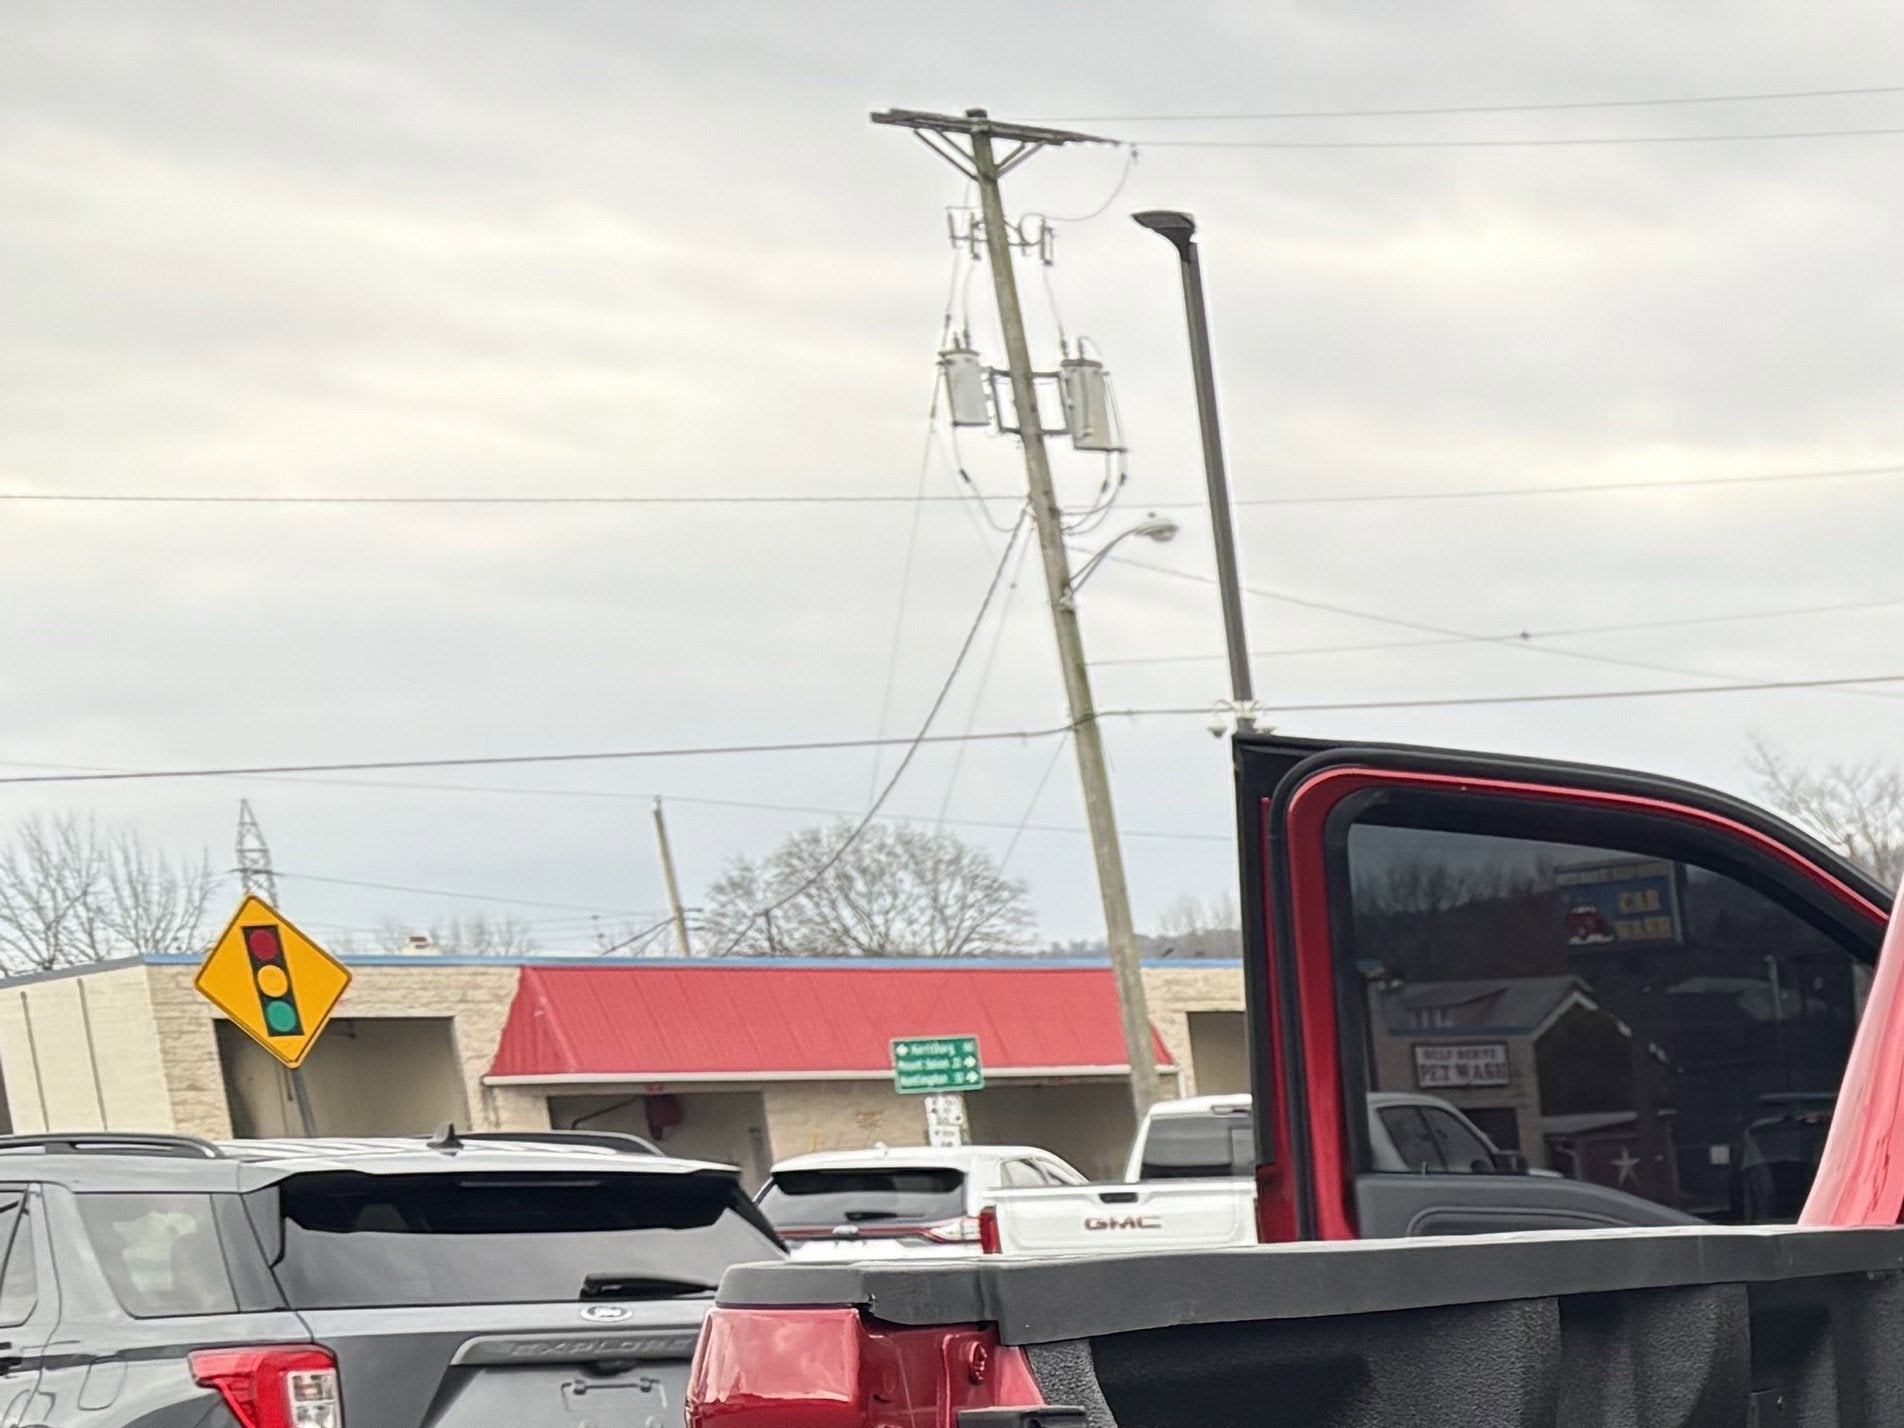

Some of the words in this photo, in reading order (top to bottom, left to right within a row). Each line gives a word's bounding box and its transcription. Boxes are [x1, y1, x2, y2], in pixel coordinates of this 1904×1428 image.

[1617, 889, 1661, 914] CAR
[1615, 916, 1673, 939] WASH
[1419, 1064, 1450, 1081] PET
[1455, 1062, 1507, 1080] WASH
[1084, 1215, 1162, 1231] GMC
